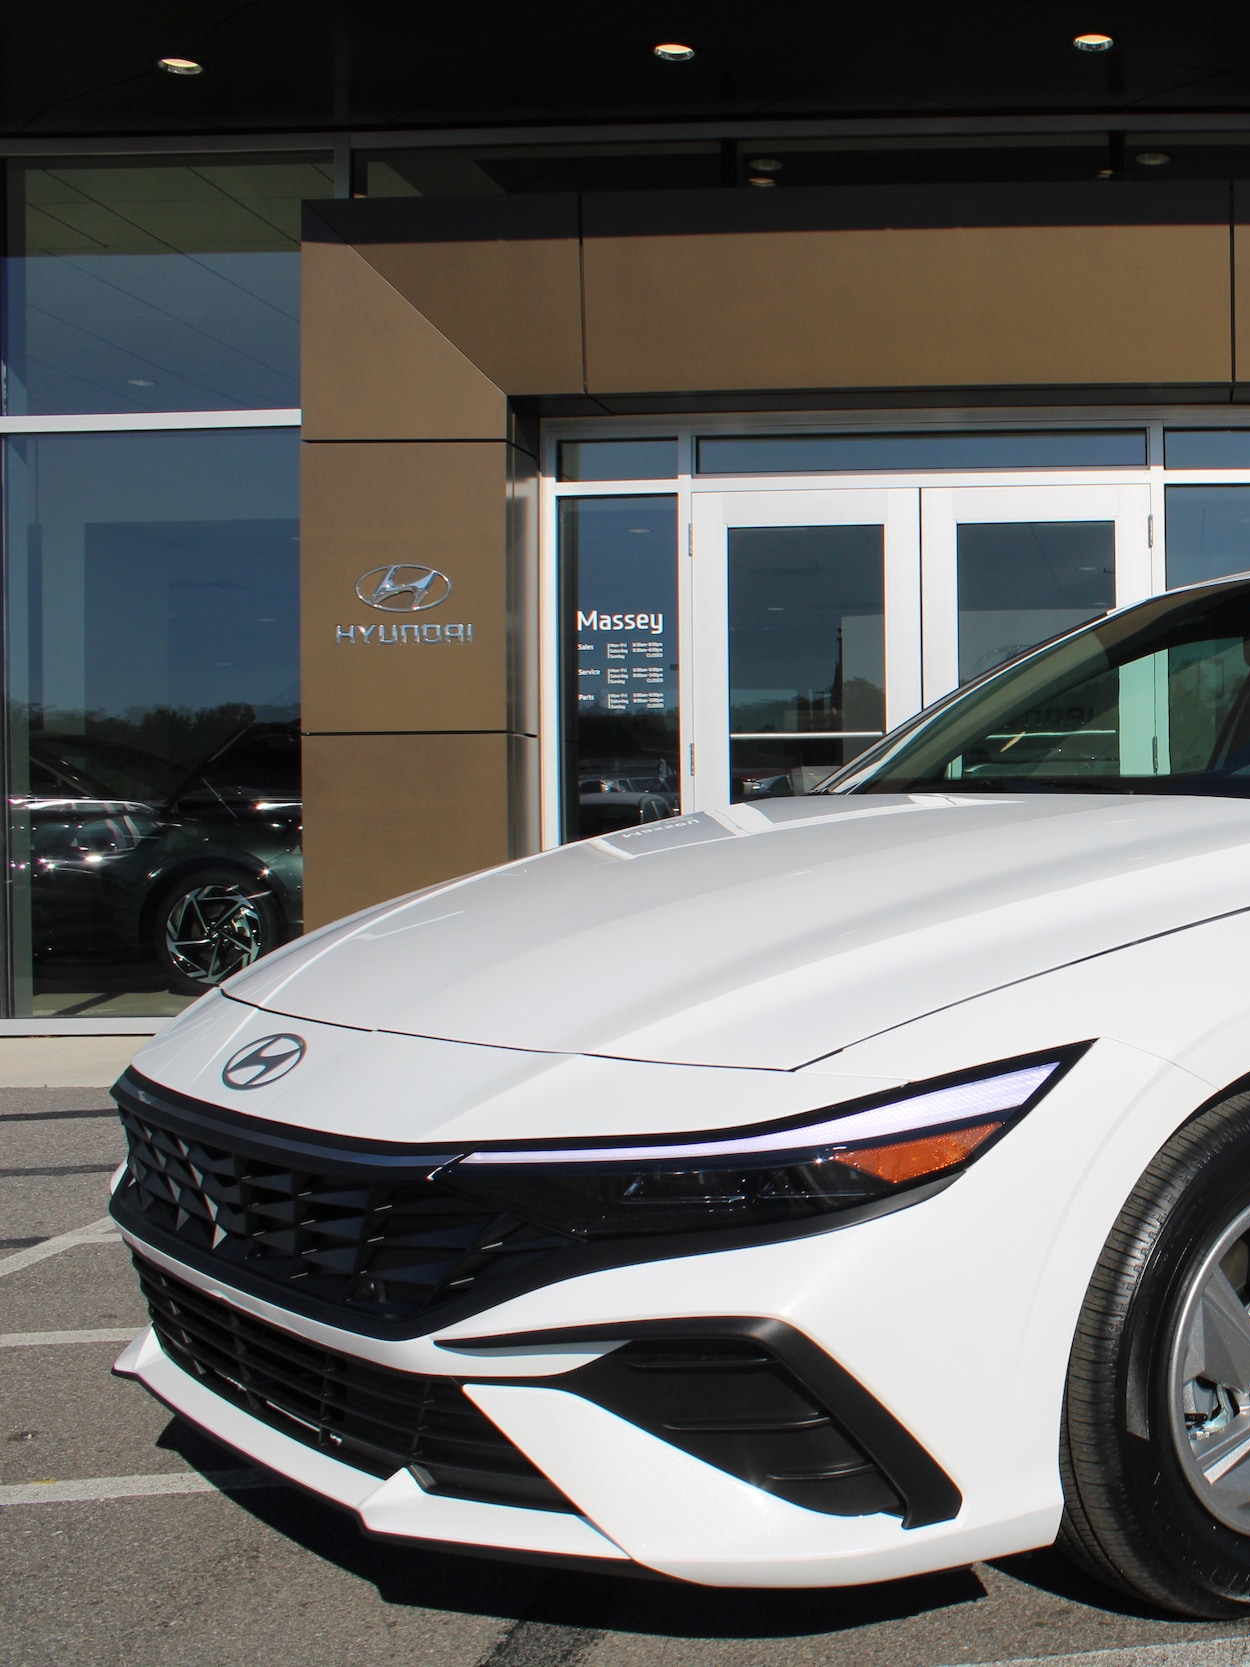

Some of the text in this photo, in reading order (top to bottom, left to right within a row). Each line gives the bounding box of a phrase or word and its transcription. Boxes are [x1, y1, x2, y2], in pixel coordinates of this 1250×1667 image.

[576, 609, 664, 635] Massey
[335, 623, 474, 645] HYUNDAI
[577, 643, 594, 651] Sales
[578, 668, 601, 676] Service
